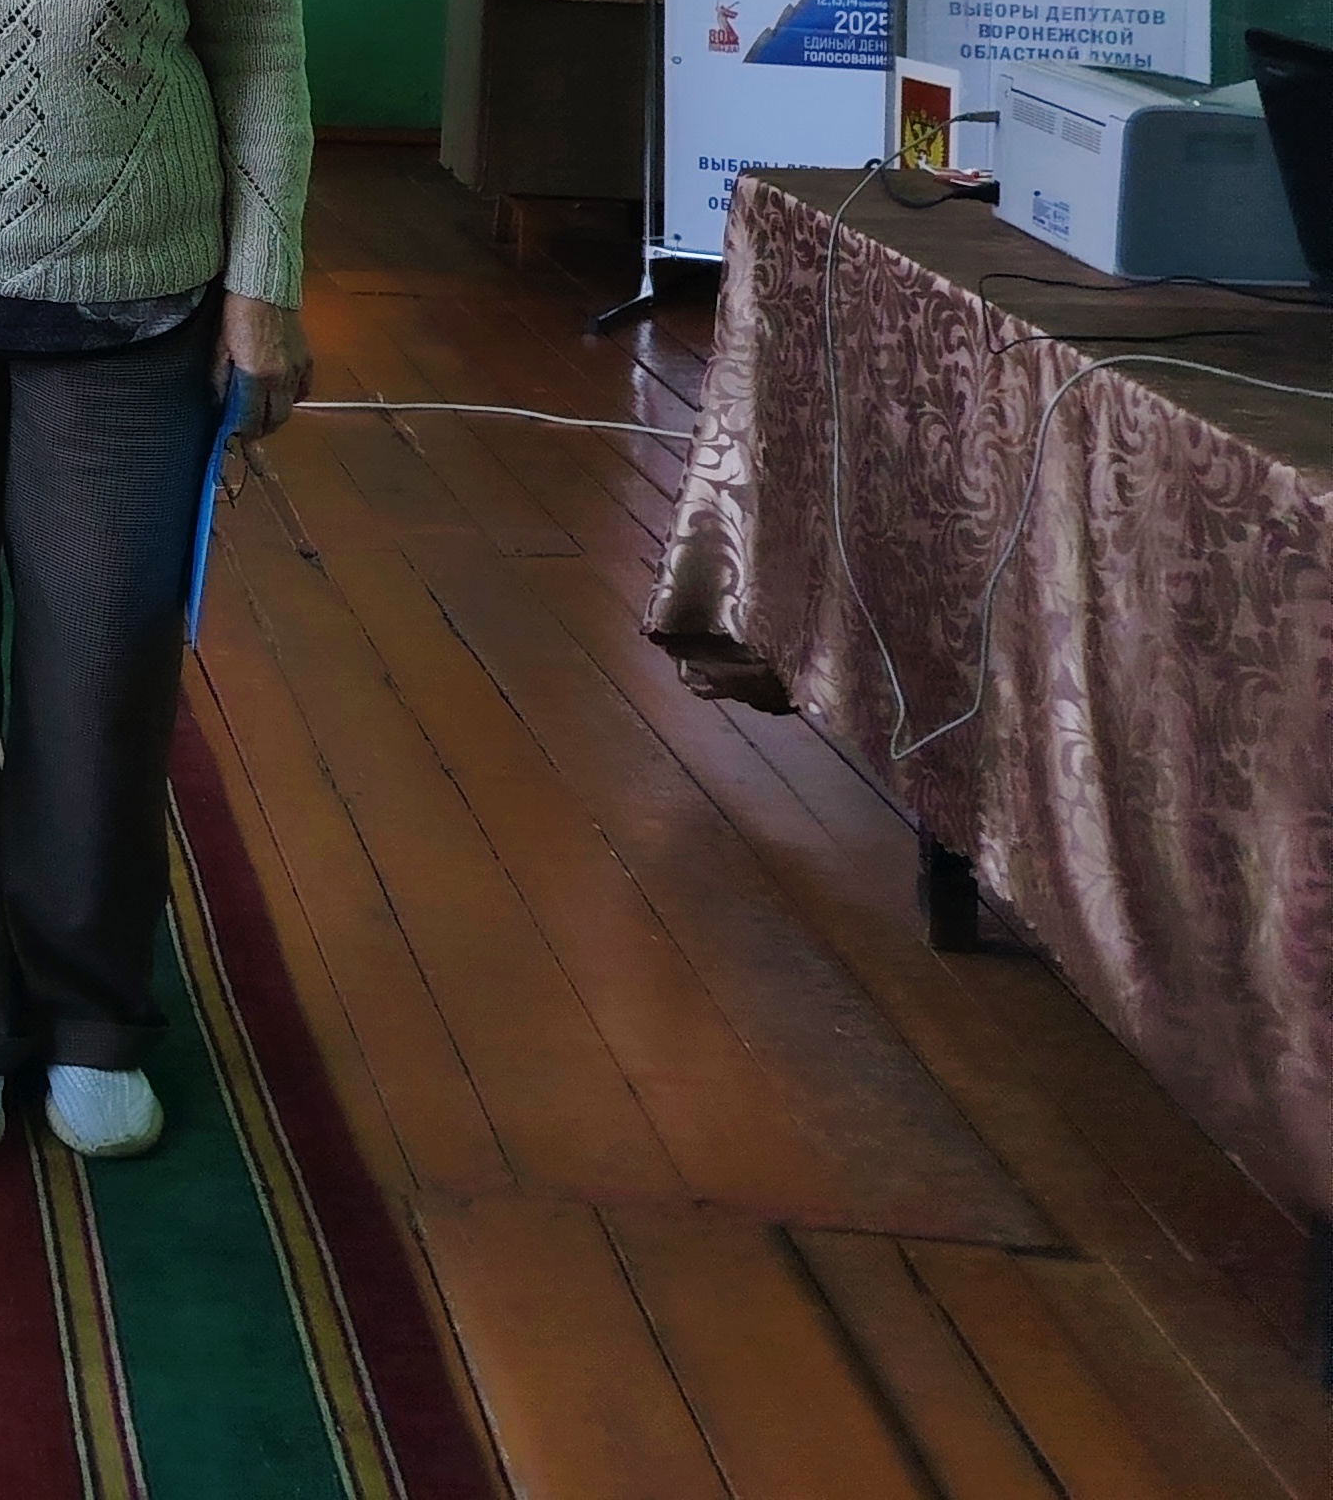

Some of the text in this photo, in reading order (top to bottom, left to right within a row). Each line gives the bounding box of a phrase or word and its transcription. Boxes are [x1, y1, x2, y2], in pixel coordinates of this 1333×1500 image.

[834, 10, 889, 36] 2025
[949, 1, 1166, 25] ВЫБОРЫ ДЕПУТАТОВ
[804, 36, 856, 51] ЕДИНЫЙ
[978, 23, 1134, 45] ВОРОНЕЖСКОЙ
